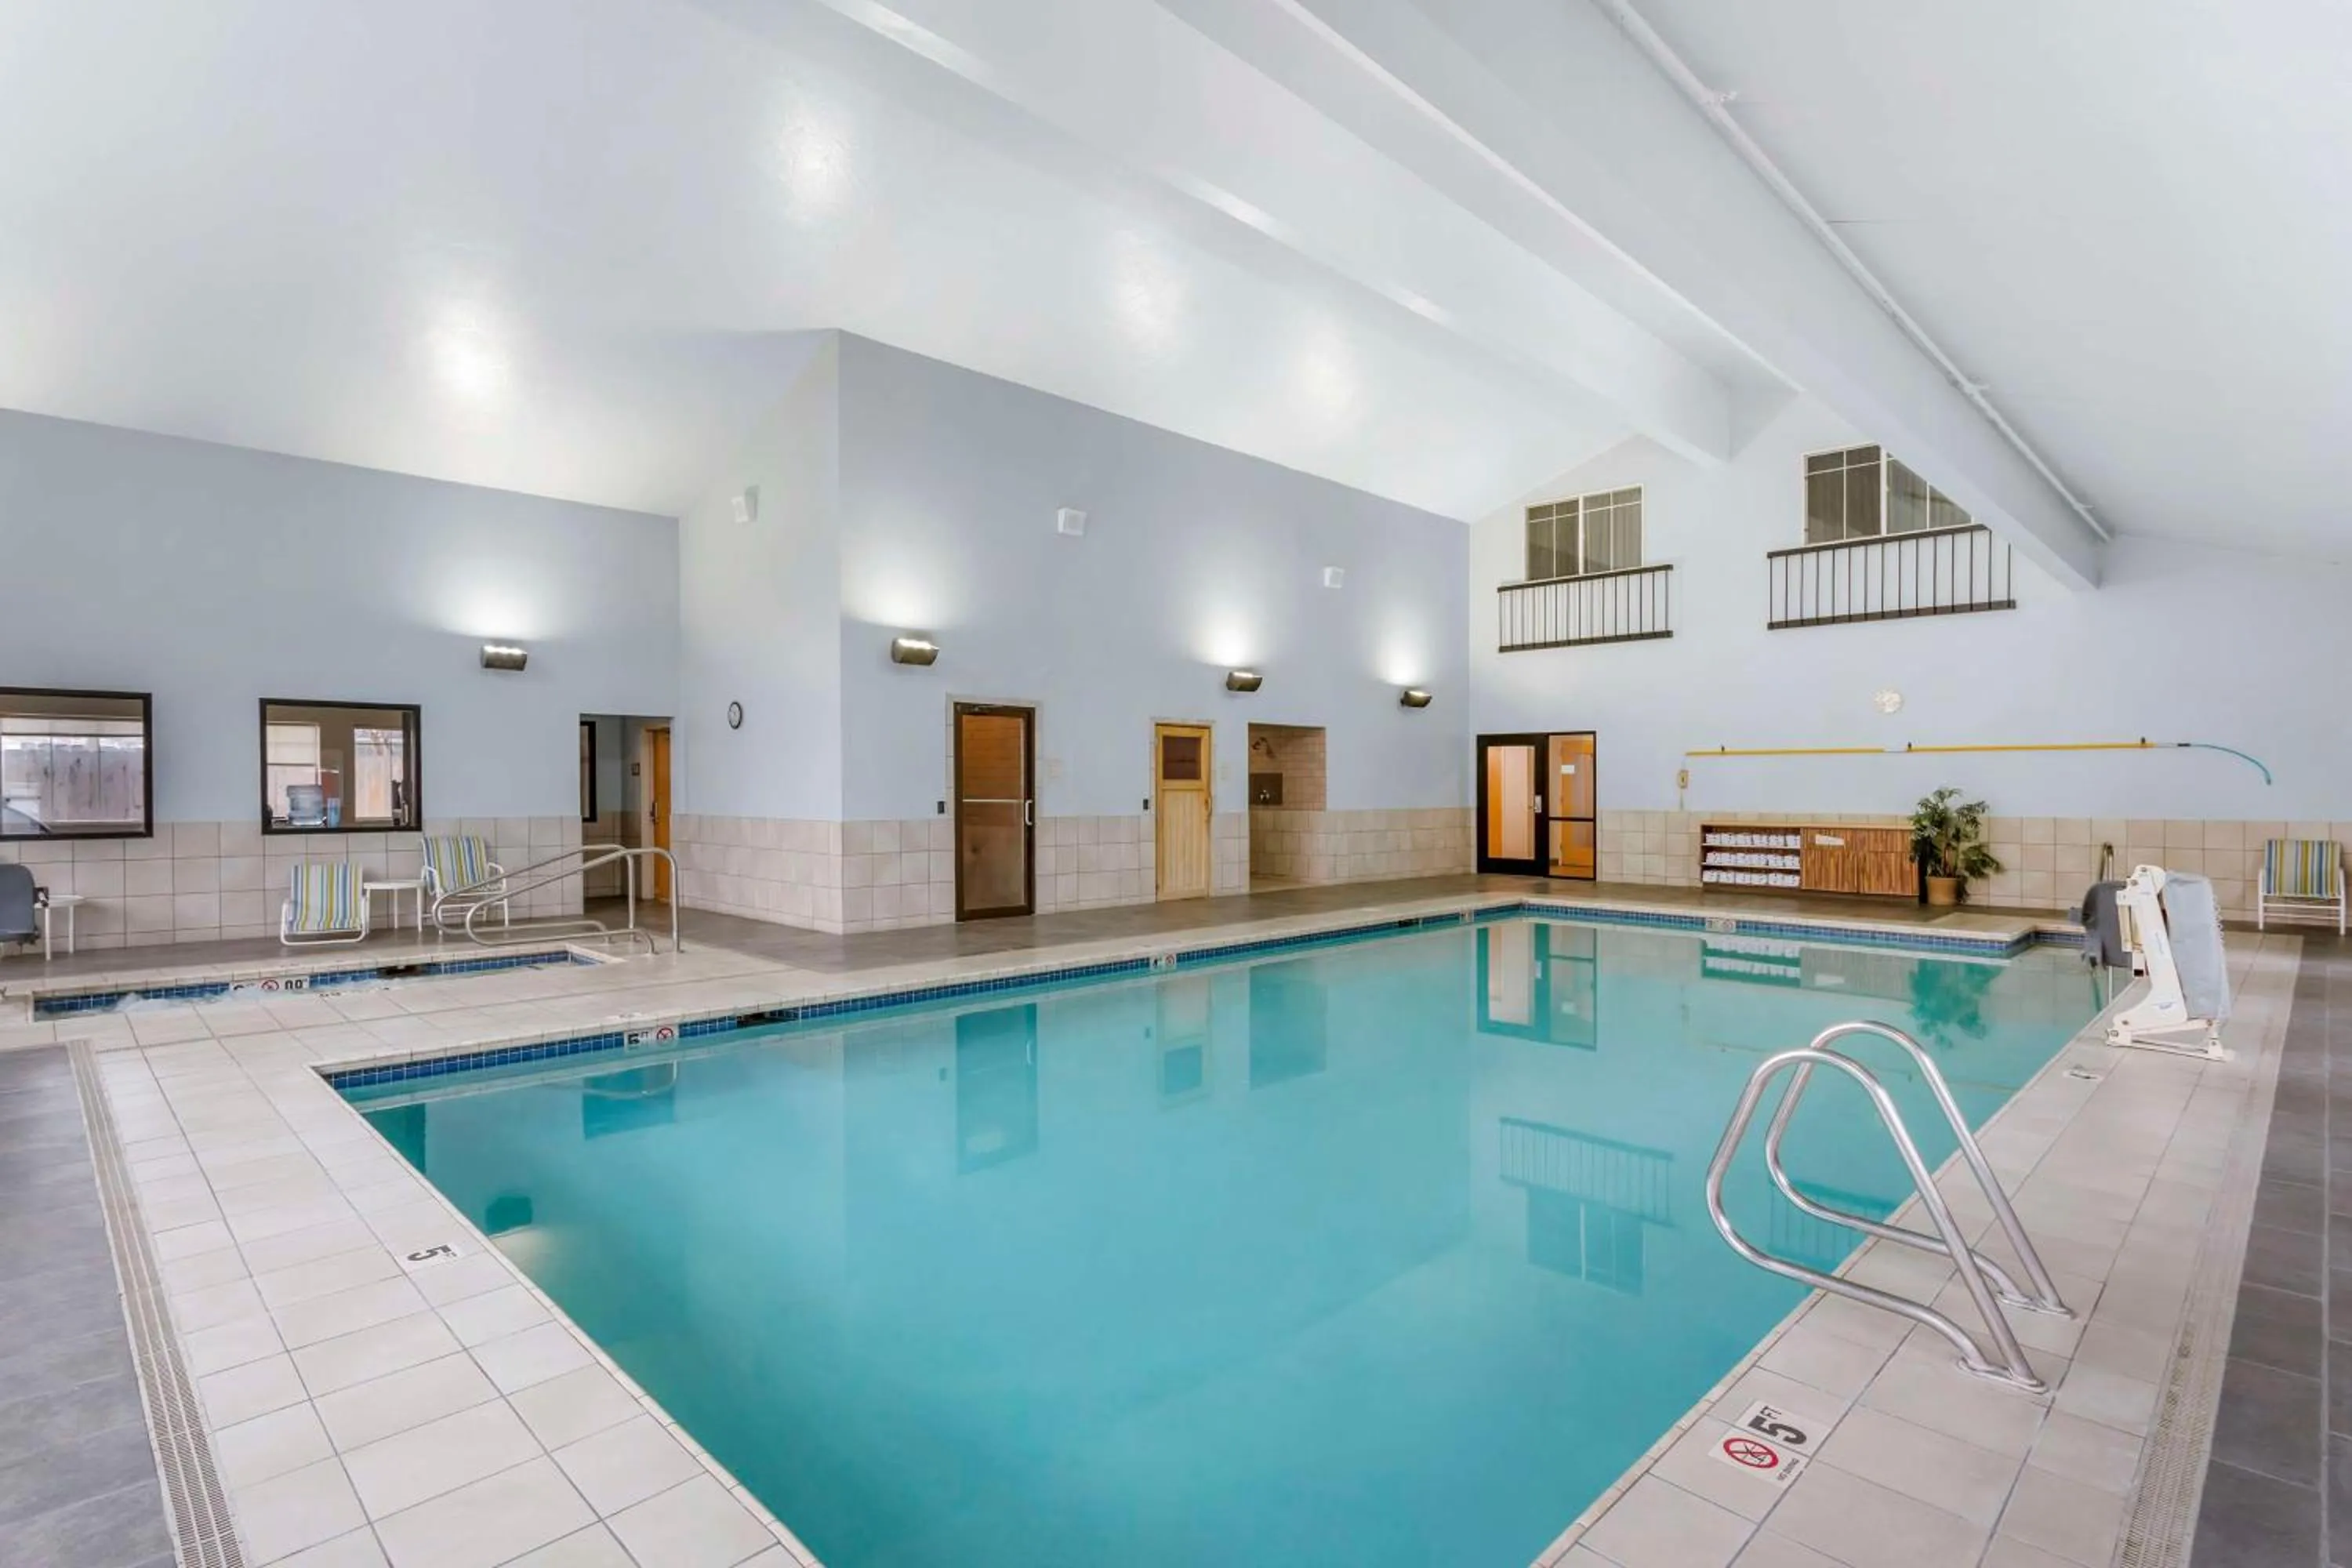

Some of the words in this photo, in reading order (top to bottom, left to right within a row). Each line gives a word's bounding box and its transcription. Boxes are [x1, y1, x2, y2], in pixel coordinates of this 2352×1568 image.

[408, 1245, 452, 1261] 5
[1759, 1406, 1781, 1420] FT
[1748, 1415, 1806, 1444] 5
